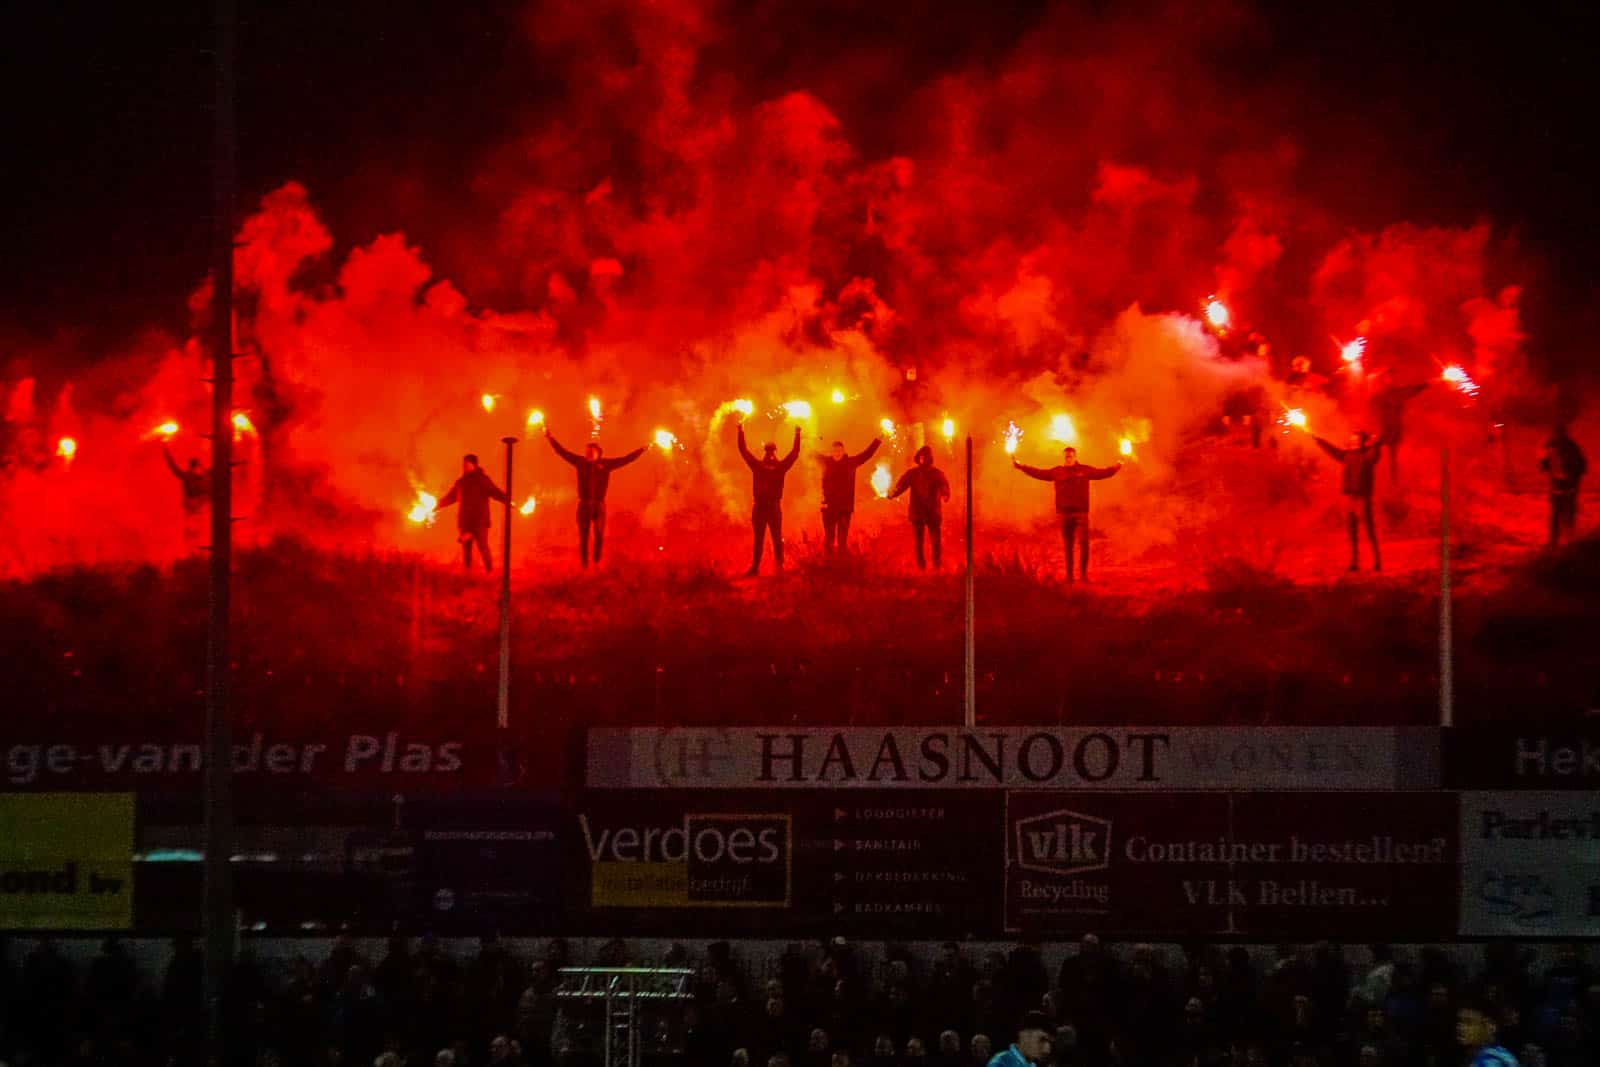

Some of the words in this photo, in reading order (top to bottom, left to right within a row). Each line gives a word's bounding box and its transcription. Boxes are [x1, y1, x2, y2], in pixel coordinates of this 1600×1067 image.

[230, 731, 327, 773] der
[345, 730, 463, 773] Plas
[755, 732, 1169, 783] HAASNOOT
[1125, 836, 1281, 863] Container
[1290, 835, 1447, 863] bestellen?
[1021, 880, 1109, 904] Recycling
